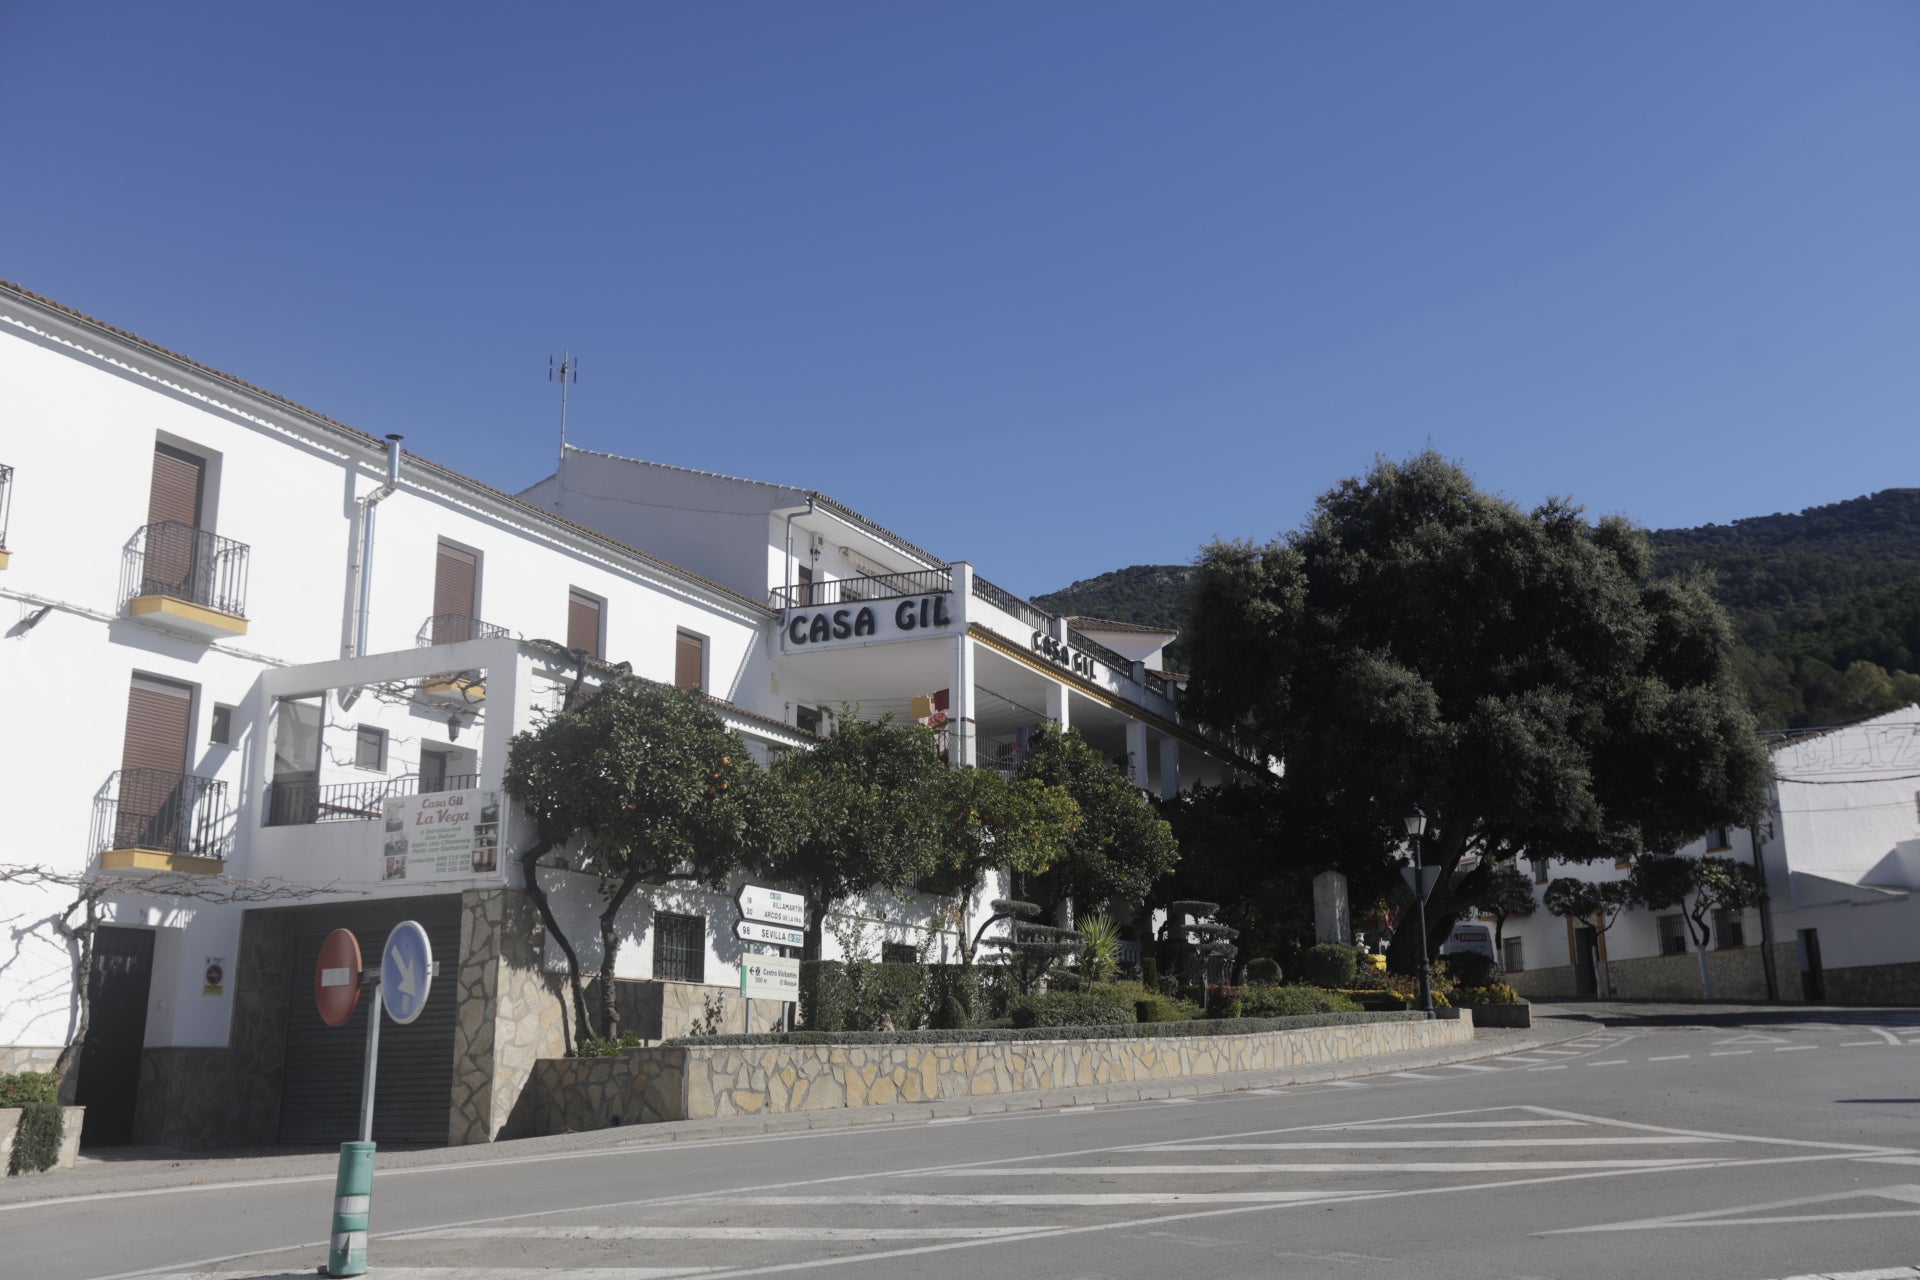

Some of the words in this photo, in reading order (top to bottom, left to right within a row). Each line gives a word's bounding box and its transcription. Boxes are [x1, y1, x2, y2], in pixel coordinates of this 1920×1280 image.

[789, 607, 875, 644] CASA
[895, 596, 951, 631] GIL
[1031, 630, 1069, 666] CASA
[1072, 651, 1097, 679] GIL
[421, 798, 447, 809] Casa
[448, 795, 464, 806] Gil
[416, 811, 434, 825] La
[436, 809, 470, 825] Vega
[772, 901, 803, 913] VILLAMARTÍN
[764, 911, 782, 920] ARCOS
[742, 926, 750, 935] 98
[761, 929, 786, 940] SEVILLA
[763, 968, 777, 977] Centro
[777, 970, 797, 979] Visitantes
